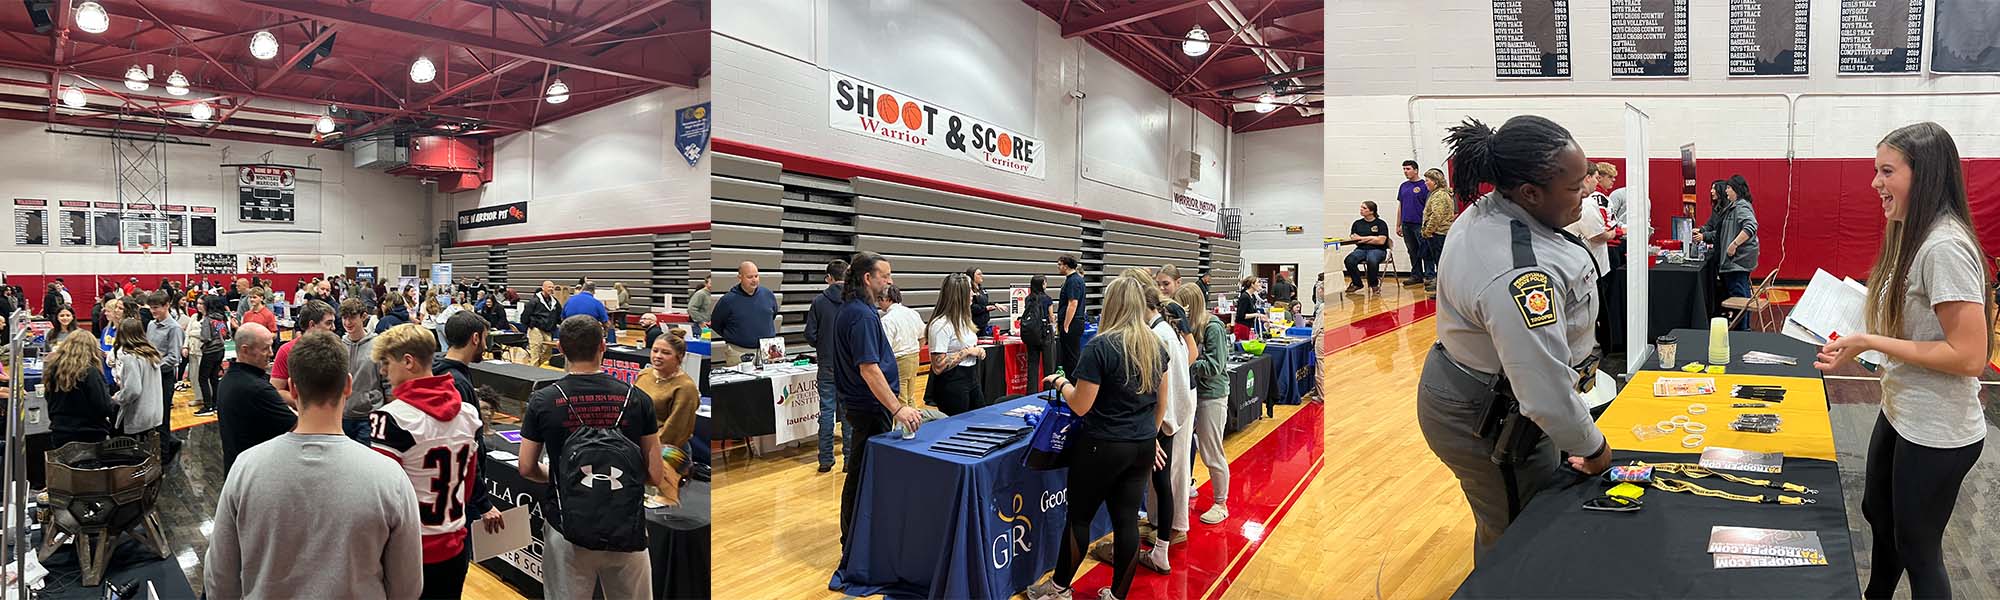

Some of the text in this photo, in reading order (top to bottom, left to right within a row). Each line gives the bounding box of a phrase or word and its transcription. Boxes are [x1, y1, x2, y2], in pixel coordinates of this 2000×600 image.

[836, 79, 1034, 163] SHOOT & SCORE
[859, 116, 1029, 174] Warrior Territory
[1174, 192, 1198, 209] WARRIOR
[470, 210, 497, 223] WARRIOR
[498, 209, 508, 220] PIT
[1530, 314, 1553, 322] TROOPER
[368, 412, 387, 440] 31
[1700, 459, 1782, 474] PATROOPER.COM
[419, 444, 470, 526] 31
[1710, 543, 1818, 559] PATROOPER.COM
[1716, 557, 1828, 568] PATROOPER.COM
